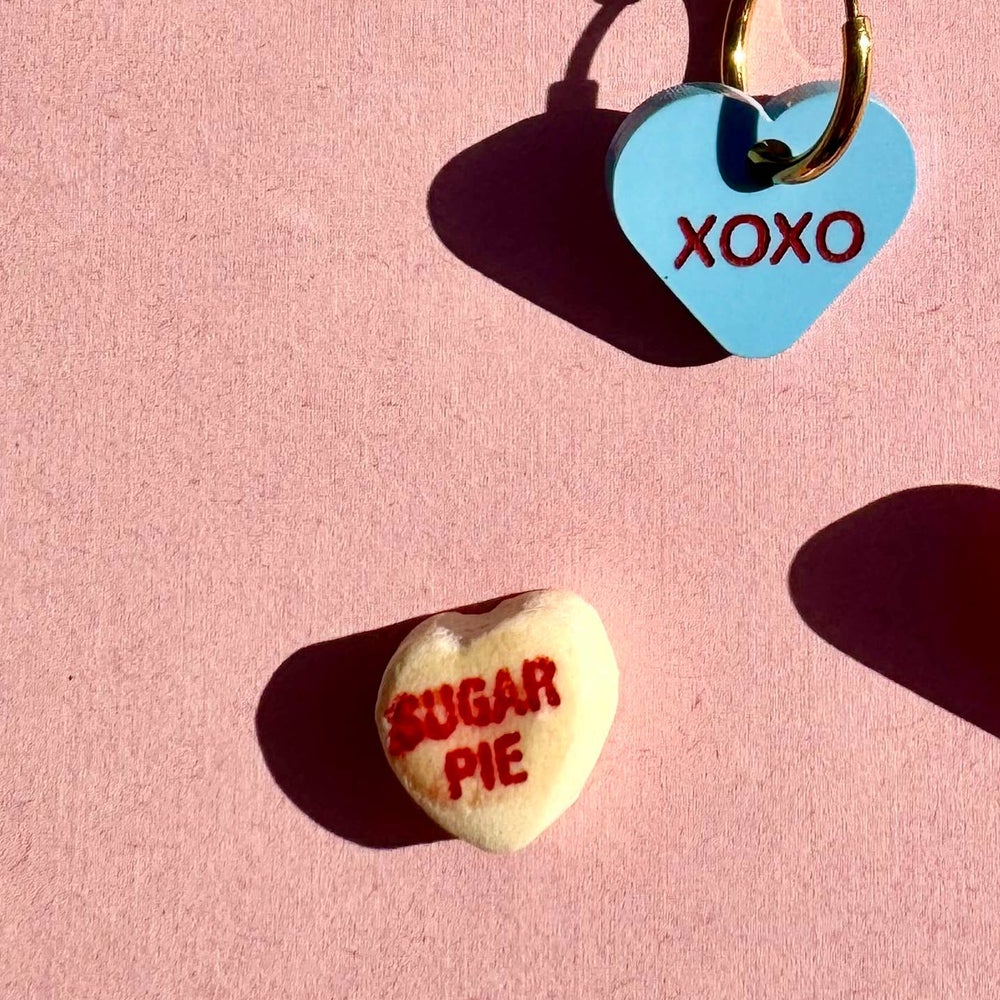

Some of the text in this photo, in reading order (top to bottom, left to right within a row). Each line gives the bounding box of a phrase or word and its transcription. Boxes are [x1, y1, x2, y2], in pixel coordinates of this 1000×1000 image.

[673, 210, 866, 271] XOXO
[385, 656, 562, 759] SUGAR
[444, 731, 529, 801] PIE
